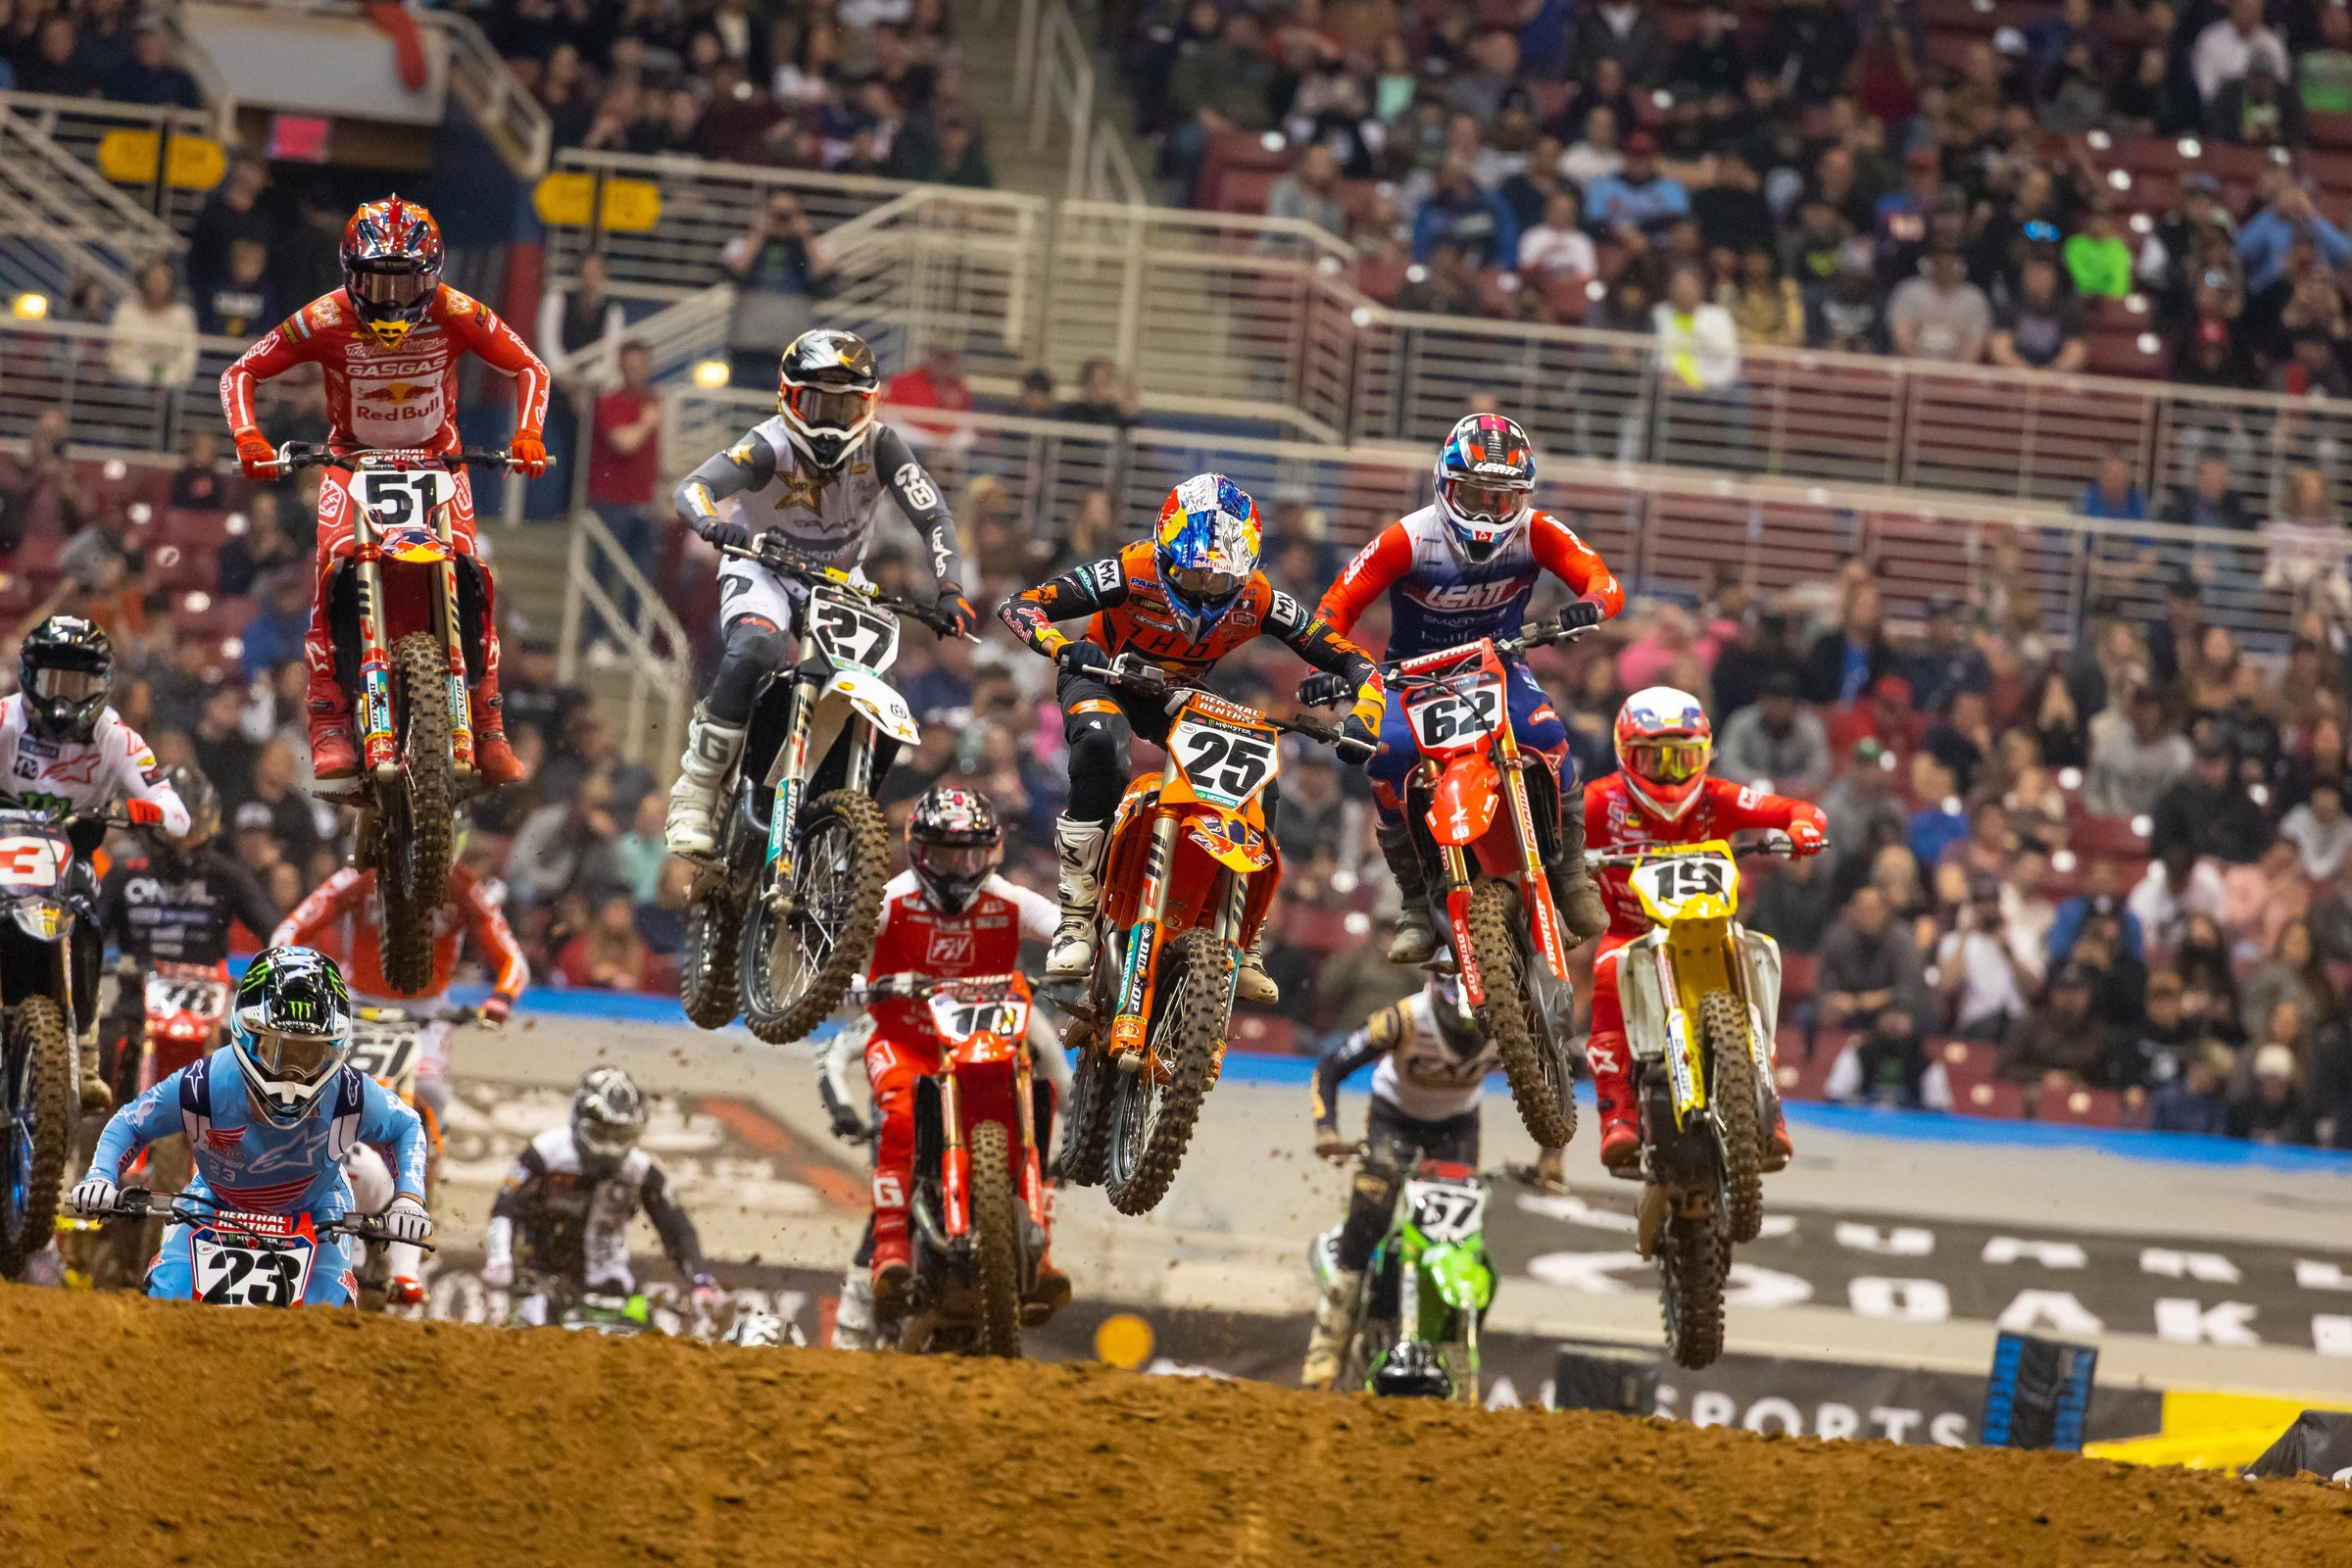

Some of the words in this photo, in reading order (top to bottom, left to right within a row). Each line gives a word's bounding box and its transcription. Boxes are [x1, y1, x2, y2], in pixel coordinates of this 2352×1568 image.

[345, 356, 448, 377] GASGAS
[357, 405, 398, 421] Red
[402, 396, 440, 420] Bull
[1474, 463, 1524, 476] LEATT
[366, 474, 438, 528] 51
[1098, 561, 1116, 587] MX
[1214, 562, 1231, 572] Bull
[1276, 593, 1295, 620] MX
[1424, 576, 1516, 609] LEATT
[1135, 613, 1175, 634] MOTOREX
[815, 607, 892, 669] 27
[456, 679, 466, 726] DUNLOP
[1535, 710, 1556, 721] LEATT
[1215, 720, 1251, 735] MONSTER
[1422, 690, 1495, 746] 62
[1184, 731, 1267, 798] 25
[1206, 794, 1236, 807] MOTOREX
[772, 799, 785, 851] MOTOREX
[784, 786, 799, 852] DUNLOP
[1654, 862, 1723, 902] 19
[1536, 897, 1558, 959] DUNLOP
[932, 935, 971, 961] FLY
[1117, 950, 1132, 1005] MOTOREX
[1456, 932, 1479, 996] DUNLOP
[276, 1020, 321, 1030] MONSTER
[209, 1159, 236, 1183] 23
[873, 1177, 906, 1207] G
[219, 1210, 286, 1224] RENTHAL
[202, 1249, 301, 1308] 23
